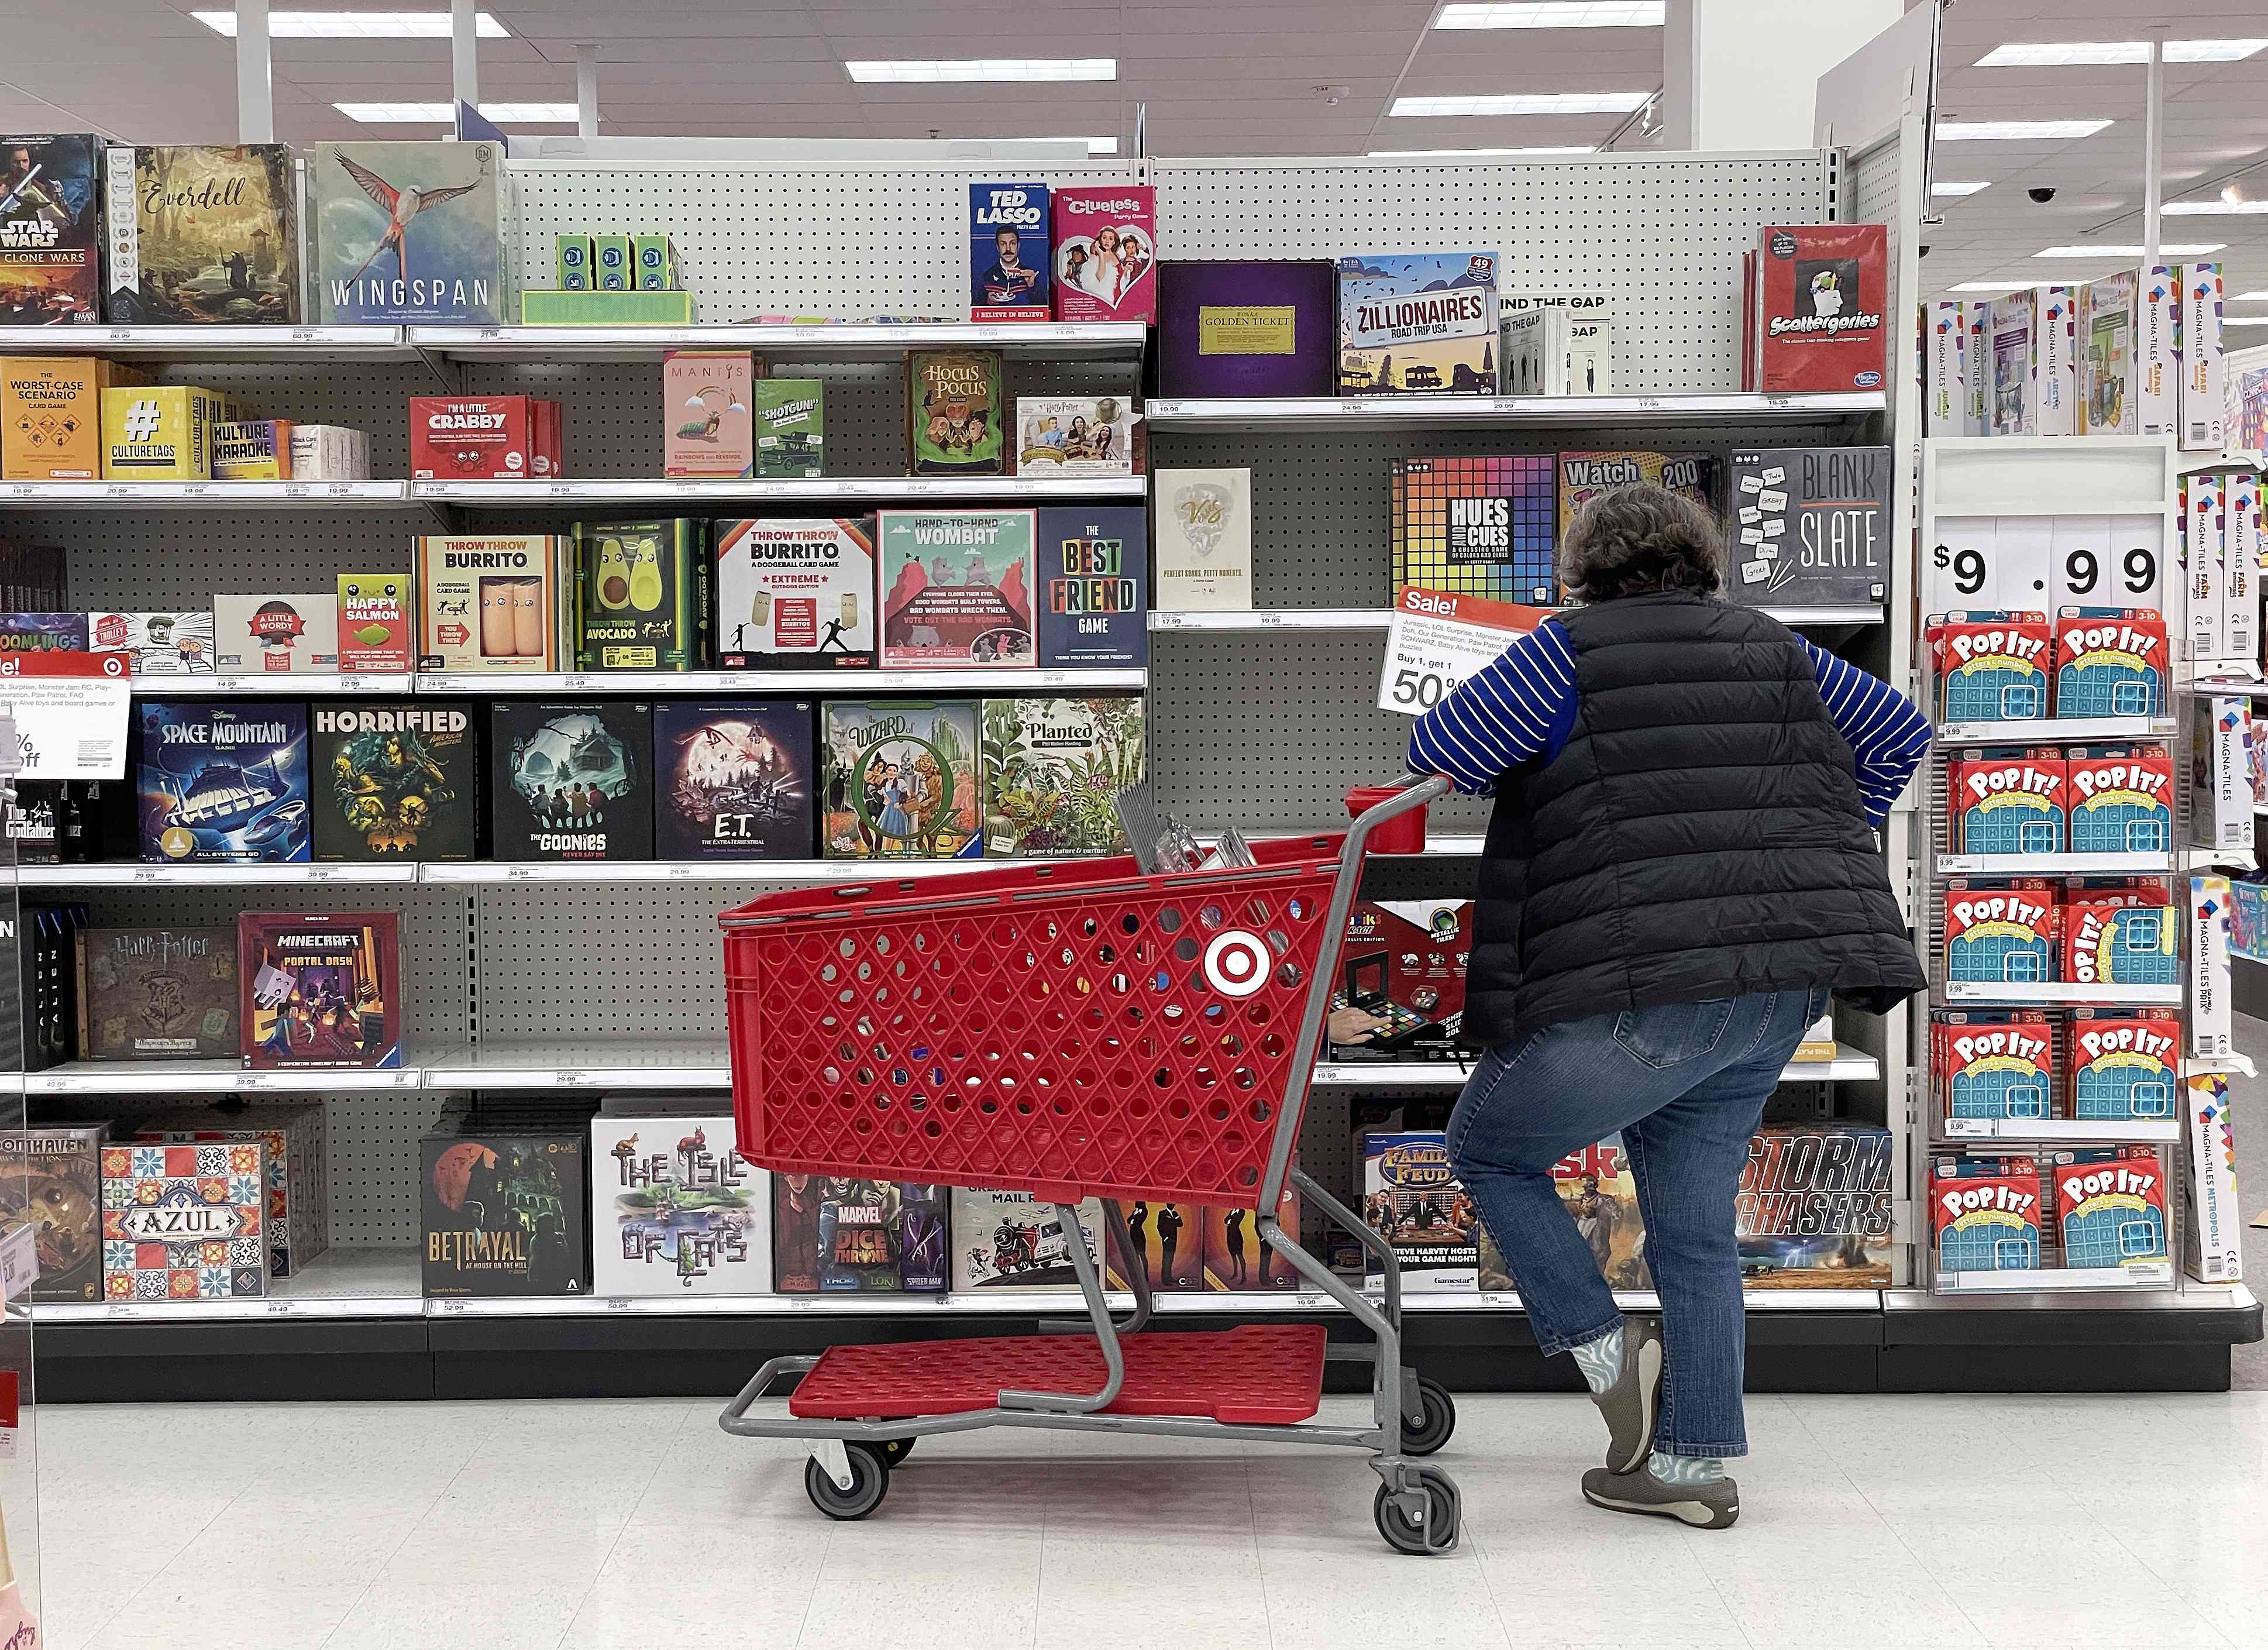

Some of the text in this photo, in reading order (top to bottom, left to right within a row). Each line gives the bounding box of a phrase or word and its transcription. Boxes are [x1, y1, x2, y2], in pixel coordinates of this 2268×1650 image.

[140, 176, 246, 214] Everdell
[990, 191, 1027, 207] TED
[977, 208, 1041, 224] LASSO
[0, 220, 58, 233] STAR
[1, 234, 58, 247] WARS
[4, 253, 85, 263] CLONE WARS
[1474, 259, 1488, 269] 49
[331, 279, 487, 305] WINGSPAN
[1357, 295, 1482, 334] ZILLIONAIRES
[1770, 311, 1880, 335] Scattergories
[1392, 323, 1447, 338] ROAD TRIP USA
[924, 365, 979, 381] HOCUS
[11, 381, 83, 390] WORST-CASE
[936, 381, 987, 398] POCUS
[18, 391, 76, 400] SCENARIO
[448, 404, 487, 412] I'M A LITTLE
[429, 414, 506, 429] CRABBY
[214, 424, 270, 441] KULTURE
[112, 445, 175, 457] CULTURETAGS
[215, 442, 271, 459] KARAOKE
[1566, 458, 1637, 486] Watch
[1663, 460, 1698, 489] 200
[1802, 453, 1875, 499] BLANK
[1451, 499, 1509, 525] HUES
[915, 518, 999, 528] HAND-TO-HAND
[1085, 525, 1099, 536] THE
[751, 531, 838, 541] THROW THROW
[916, 528, 998, 545] WOMBAT
[1452, 527, 1509, 546] AND CUES
[1800, 511, 1877, 567] SLATE
[2198, 514, 2206, 570] MAGNA-TILES
[445, 541, 527, 550] THROW THROW
[445, 553, 527, 568] BURRITO
[1065, 542, 1120, 572] BEST
[1746, 566, 1766, 577] Great
[346, 598, 398, 609] HAPPY
[1053, 580, 1133, 611] FRIEND
[1405, 591, 1458, 616] Sale!
[267, 615, 292, 623] LITTLE
[346, 611, 399, 620] SALMON
[260, 622, 293, 630] WORDY
[586, 629, 636, 640] AVOCADO
[1078, 618, 1109, 634] GAME
[1952, 631, 2045, 662] POP IT!
[1398, 653, 1416, 663] Buy
[1419, 658, 1425, 666] 1,
[1429, 659, 1444, 669] get
[316, 710, 467, 733] HORRIFIED
[161, 721, 287, 744] SPACE MOUNTAIN
[1025, 723, 1093, 740] Planted
[2221, 734, 2231, 801] MAGNA-TILES
[1967, 767, 2061, 799] POP IT!
[6, 804, 26, 820] The
[5, 820, 56, 840] Godfather
[714, 813, 751, 838] E.T.
[277, 936, 359, 947] MINECRAFT
[1431, 927, 1460, 939] METALLIC
[284, 957, 352, 966] PORTAL DASH
[2200, 921, 2208, 989] MAGNA-TILES
[611, 1149, 748, 1192] THE ISLE
[1739, 1135, 1892, 1192] STORM
[1395, 1164, 1450, 1184] FEUD
[2202, 1124, 2219, 1247] MAGNA-TILES METROPOLIS
[992, 1194, 1025, 1204] MAIL
[2079, 1199, 2144, 1212] letters numbers
[141, 1211, 221, 1233] AZUL
[838, 1206, 881, 1223] MARVEL
[1735, 1192, 1892, 1236] CHASERS
[837, 1230, 885, 1249] DICE
[428, 1230, 526, 1271] BETRAYAL
[870, 1277, 894, 1287] LOKI
[907, 1277, 941, 1287] SPIDER-MAN
